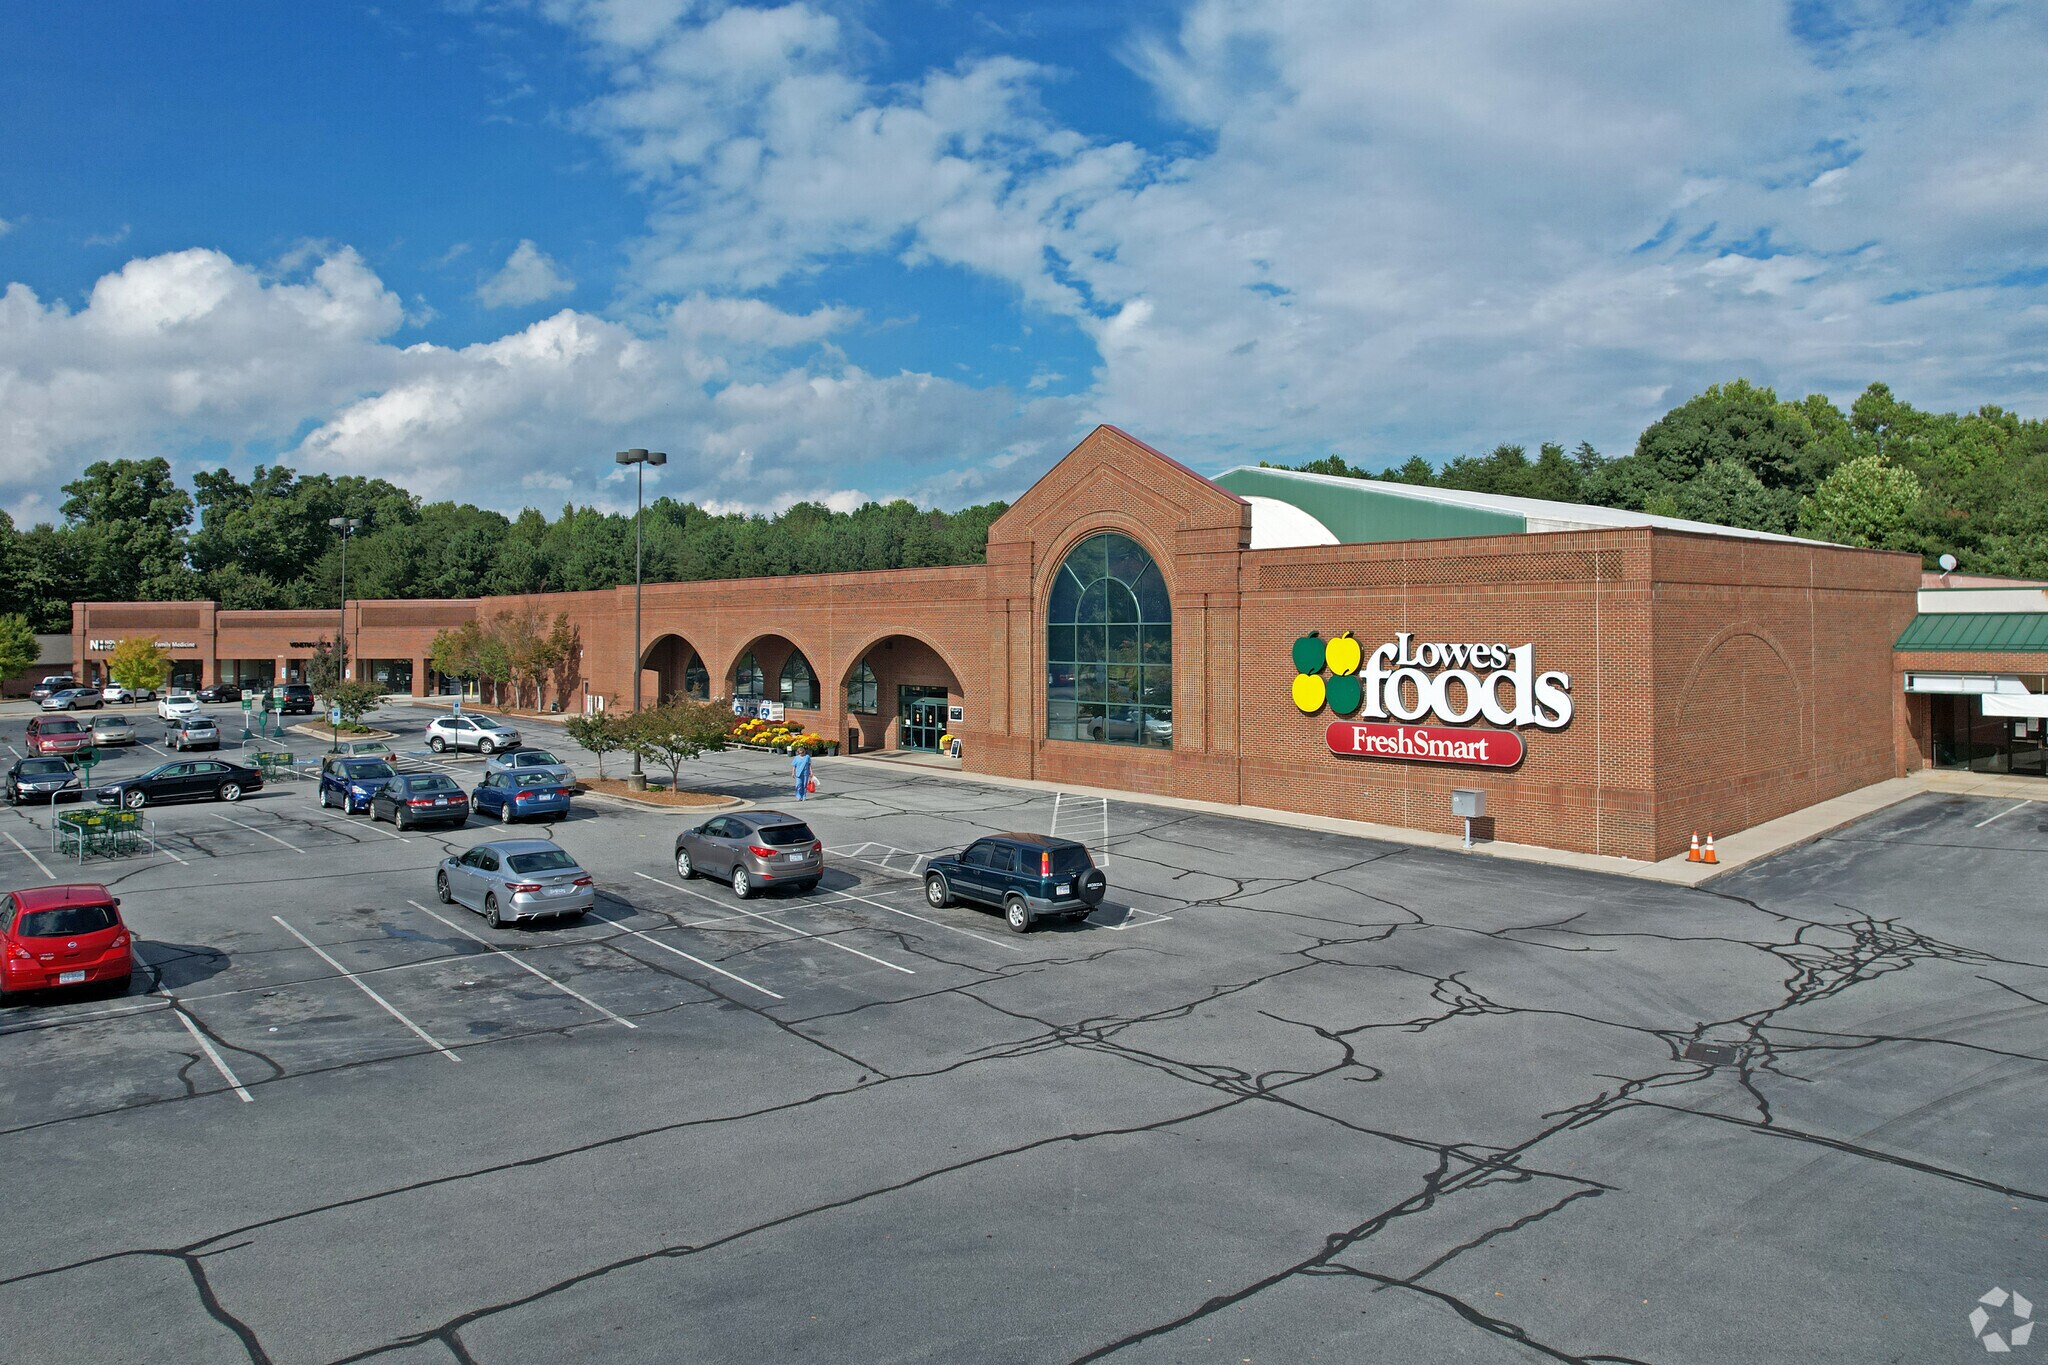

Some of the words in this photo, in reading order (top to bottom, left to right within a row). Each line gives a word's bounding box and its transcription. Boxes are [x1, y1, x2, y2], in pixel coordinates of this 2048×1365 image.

[1395, 632, 1508, 669] Lowes
[1360, 643, 1573, 728] foods
[1351, 726, 1490, 761] FreshSmart
